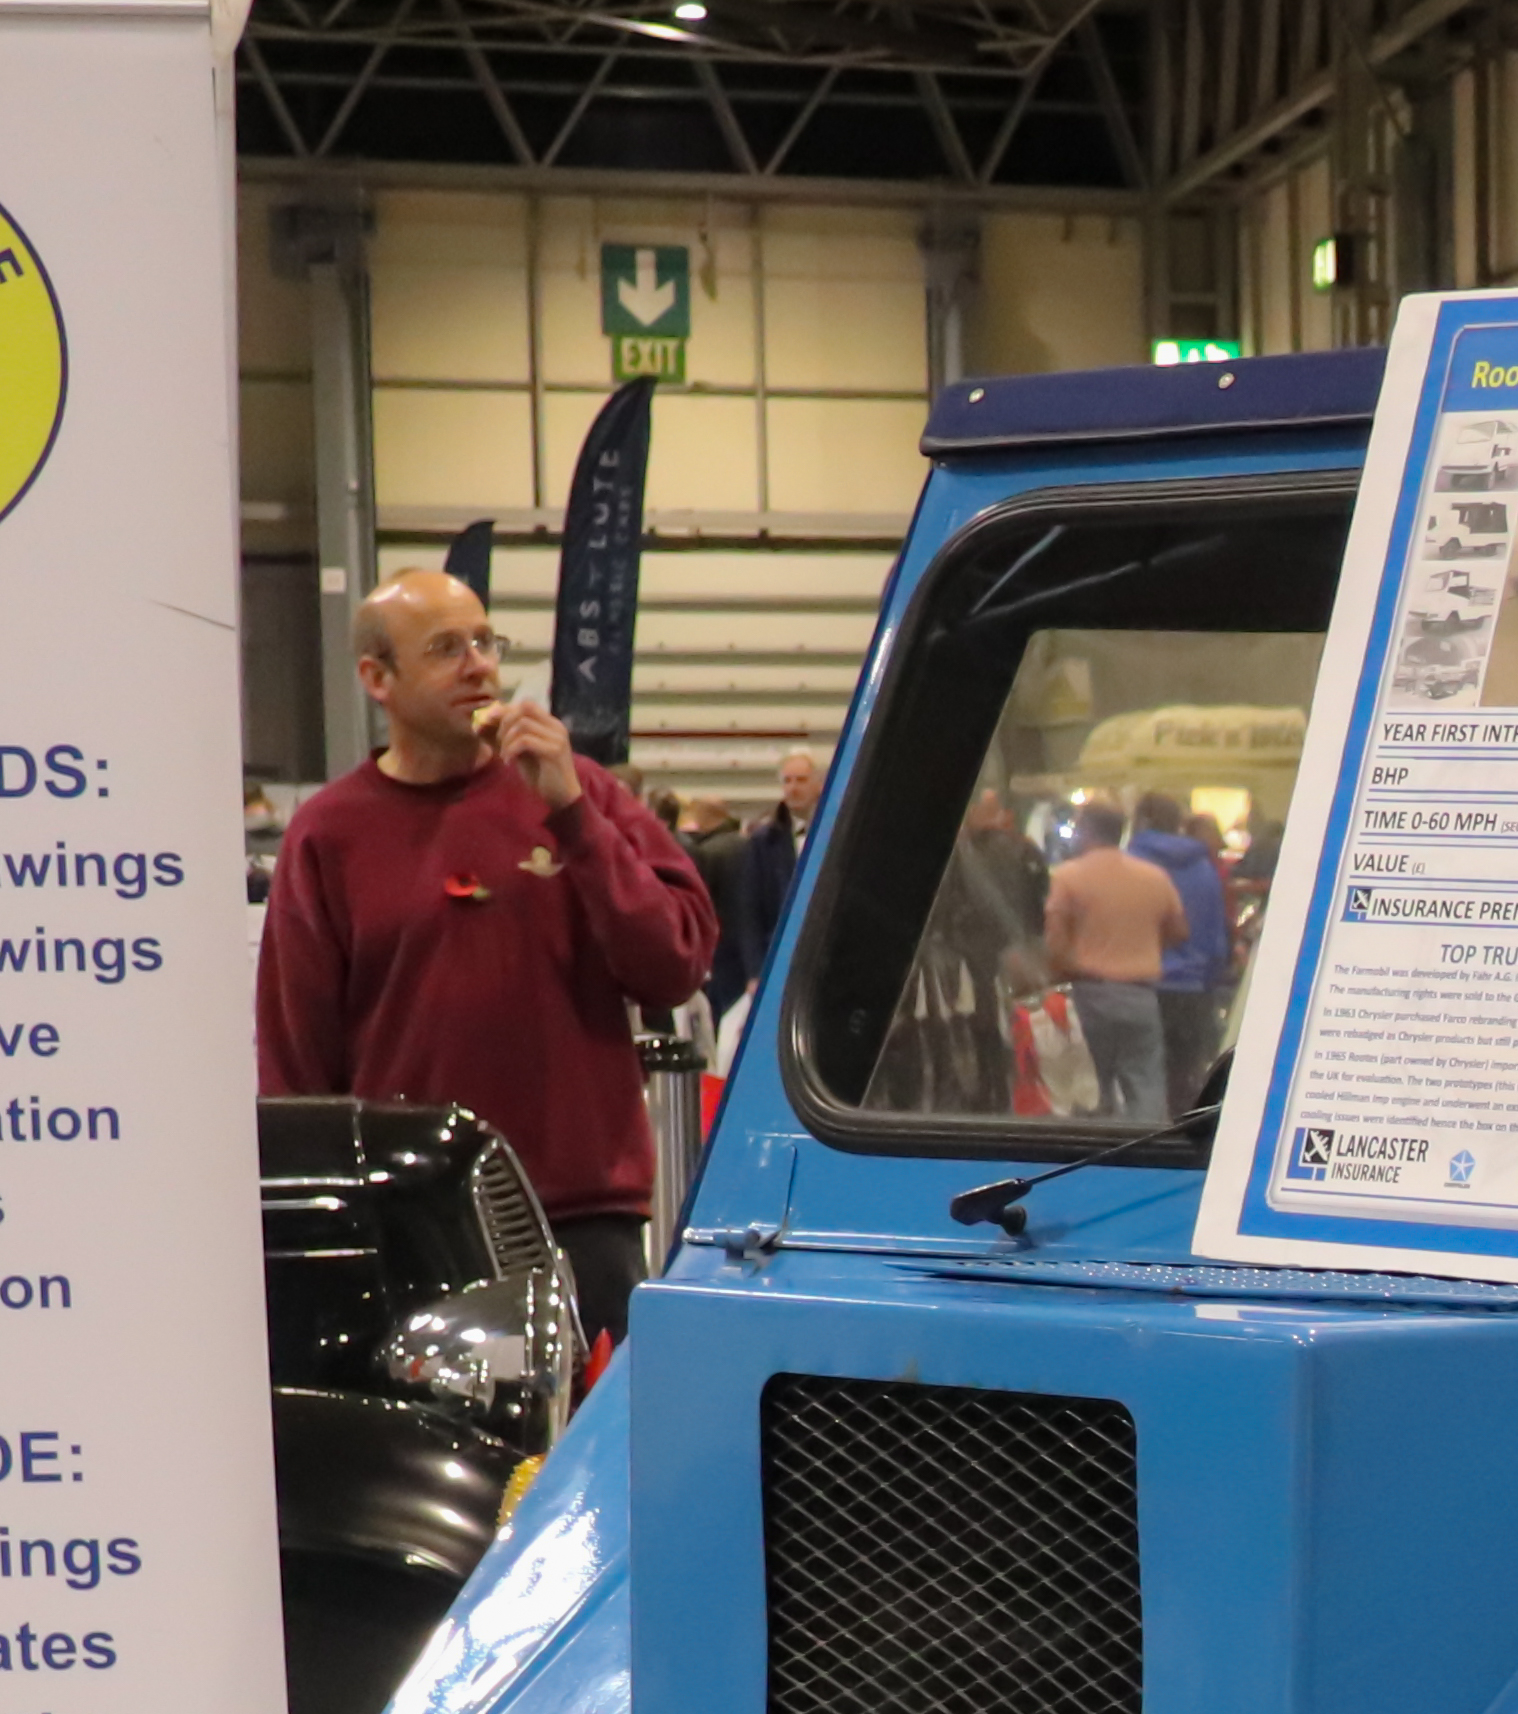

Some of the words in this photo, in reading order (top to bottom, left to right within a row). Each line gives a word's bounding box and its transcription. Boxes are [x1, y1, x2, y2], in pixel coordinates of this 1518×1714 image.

[621, 338, 682, 376] EXIT
[1383, 722, 1426, 743] YEAR
[1431, 724, 1480, 744] FIRST
[0, 744, 109, 799] DS:
[1371, 766, 1409, 785] BHP
[1363, 810, 1407, 831] TIME
[1411, 811, 1450, 832] 0-60
[1453, 812, 1498, 833] MPH
[0, 842, 184, 900] wings
[1352, 853, 1410, 874] VALUE
[1371, 898, 1476, 921] INSURANCE
[1440, 944, 1477, 965] TOP
[1335, 963, 1350, 975] The
[1351, 964, 1390, 976] Farmobil
[1392, 968, 1409, 977] was
[1411, 966, 1459, 981] developed
[1459, 969, 1471, 982] by
[1472, 970, 1493, 981] Fahr
[1330, 983, 1345, 994] The
[1412, 987, 1438, 1001] rights
[1440, 991, 1463, 1000] were
[1464, 990, 1484, 1001] sold
[1485, 991, 1495, 1001] to
[1496, 991, 1512, 1003] the
[1323, 1006, 1332, 1016] In
[1357, 1007, 1394, 1021] Chrysler
[1394, 1011, 1443, 1023] purchased
[1442, 1009, 1467, 1024] Farco
[1468, 1014, 1518, 1029] rebranding
[1320, 1028, 1341, 1037] were
[1397, 1029, 1434, 1043] Chrysler
[1435, 1033, 1475, 1044] products
[1477, 1034, 1493, 1046] but
[1314, 1049, 1323, 1059] In
[1403, 1055, 1435, 1066] owned
[1436, 1055, 1449, 1069] by
[1310, 1069, 1325, 1080] the
[1326, 1070, 1340, 1081] UK
[1341, 1070, 1355, 1082] for
[1407, 1074, 1423, 1086] The
[1425, 1076, 1442, 1087] two
[1305, 1089, 1336, 1100] cooled
[1391, 1095, 1421, 1107] engine
[1422, 1095, 1440, 1107] and
[1441, 1097, 1490, 1110] underwent
[1492, 1101, 1504, 1111] an
[0, 1096, 120, 1141] tion
[1300, 1109, 1333, 1123] cooling
[1334, 1111, 1360, 1122] issues
[1363, 1114, 1384, 1124] were
[1430, 1116, 1457, 1129] hence
[1459, 1118, 1475, 1130] the
[1475, 1118, 1495, 1131] box
[1495, 1122, 1507, 1132] on
[1336, 1134, 1429, 1163] LANCASTER
[1331, 1162, 1402, 1184] INSURANCE
[0, 1275, 71, 1310] on
[0, 1526, 142, 1591] ings
